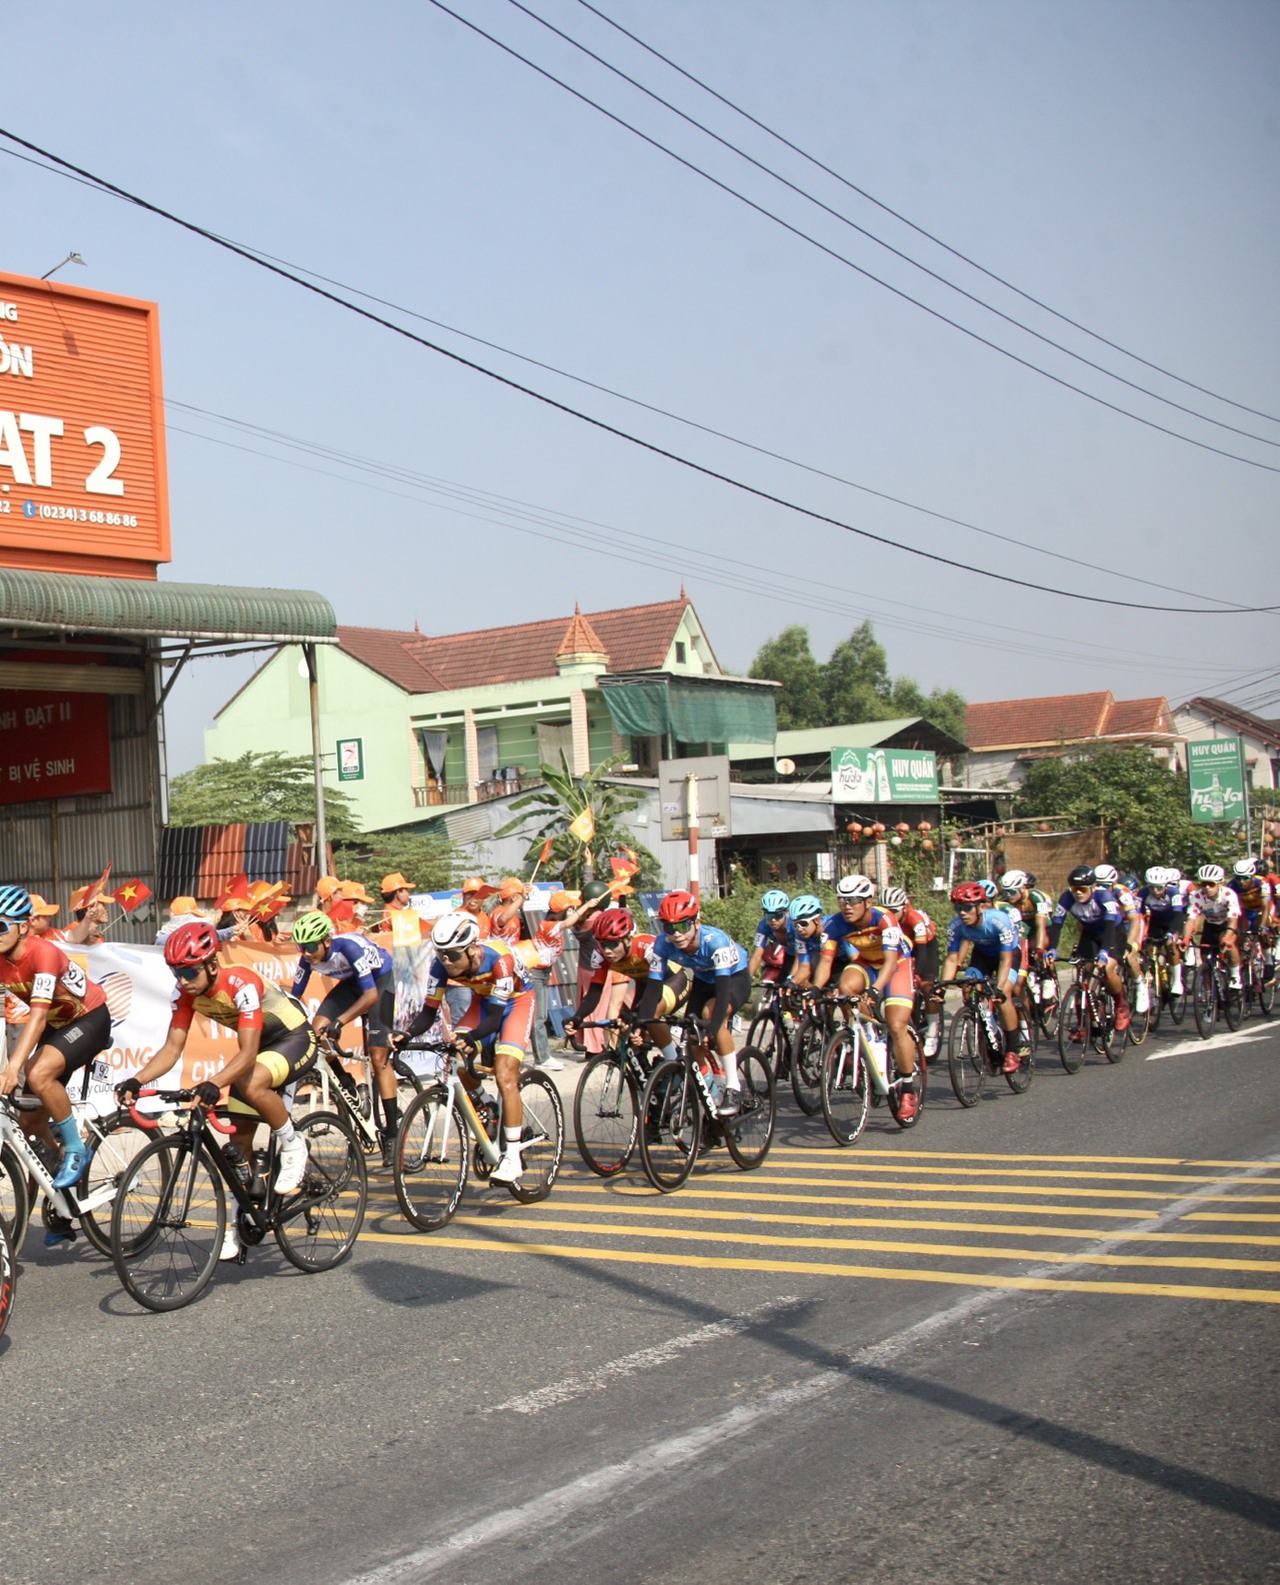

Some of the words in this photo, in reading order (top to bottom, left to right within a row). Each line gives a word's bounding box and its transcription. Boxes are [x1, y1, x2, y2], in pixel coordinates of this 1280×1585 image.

[83, 425, 125, 497] 2
[39, 504, 78, 522] (0234)
[80, 508, 87, 522] 3
[89, 508, 104, 524] 68
[106, 510, 121, 526] 86
[123, 512, 138, 528] 86
[25, 701, 57, 732] ĐẠT
[1192, 745, 1210, 756] HUY
[1211, 741, 1236, 755] QUÁN
[9, 766, 22, 786] BỊ
[25, 757, 41, 783] VỆ
[45, 758, 76, 776] SINH
[891, 759, 909, 778] HUY
[910, 756, 934, 780] QUÁN
[35, 976, 52, 992] 92
[98, 1064, 110, 1079] 92
[191, 1055, 225, 1083] CHÀ
